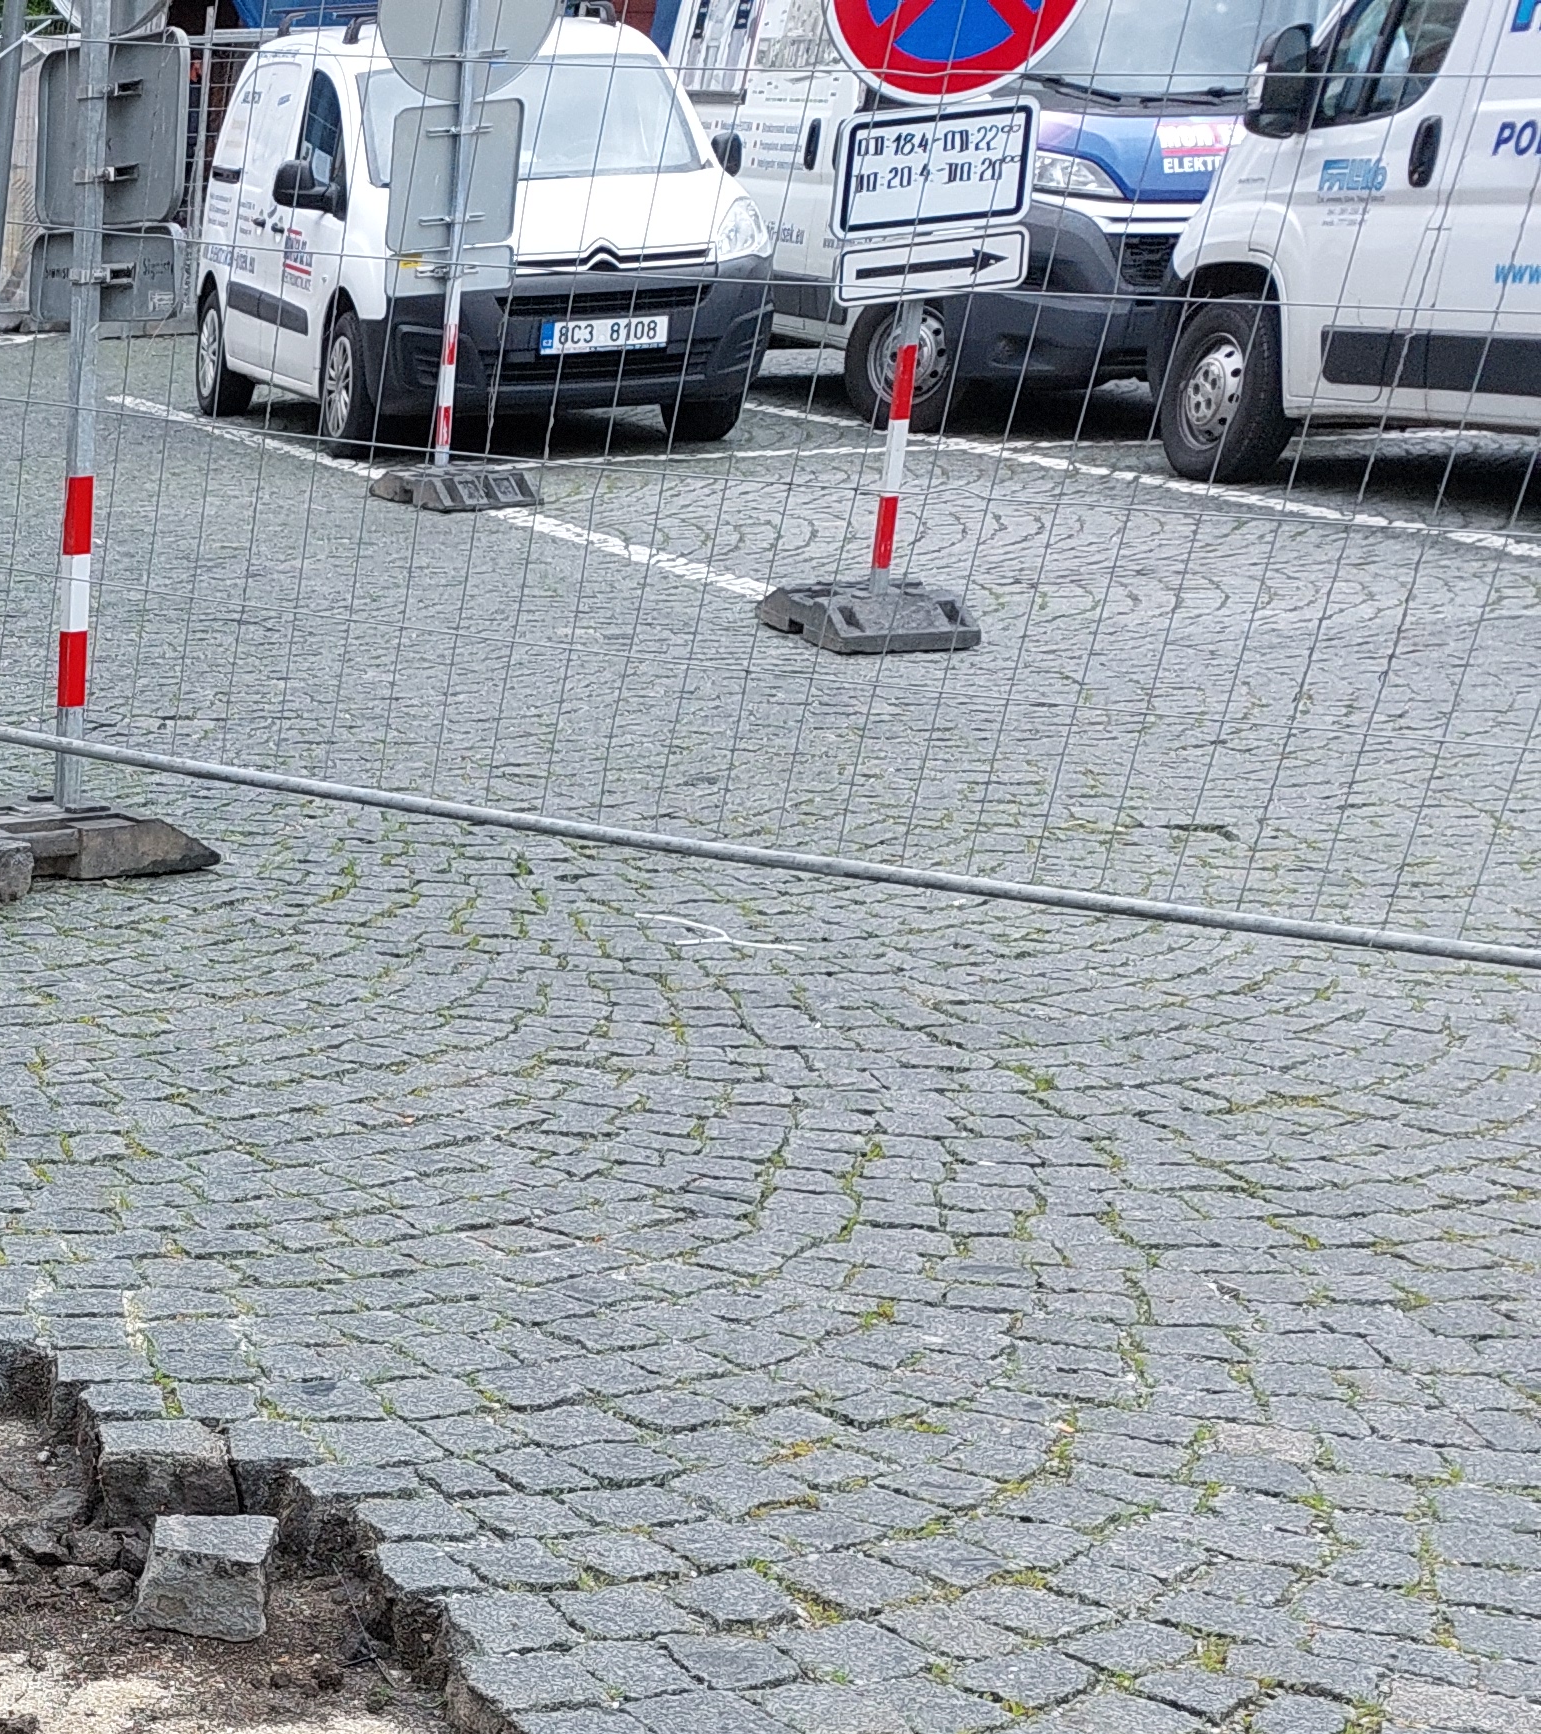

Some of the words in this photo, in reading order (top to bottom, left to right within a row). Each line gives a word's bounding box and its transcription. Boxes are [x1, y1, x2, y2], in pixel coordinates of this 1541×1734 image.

[1491, 119, 1541, 156] PO
[558, 323, 595, 346] 8C3
[609, 319, 658, 343] 8108
